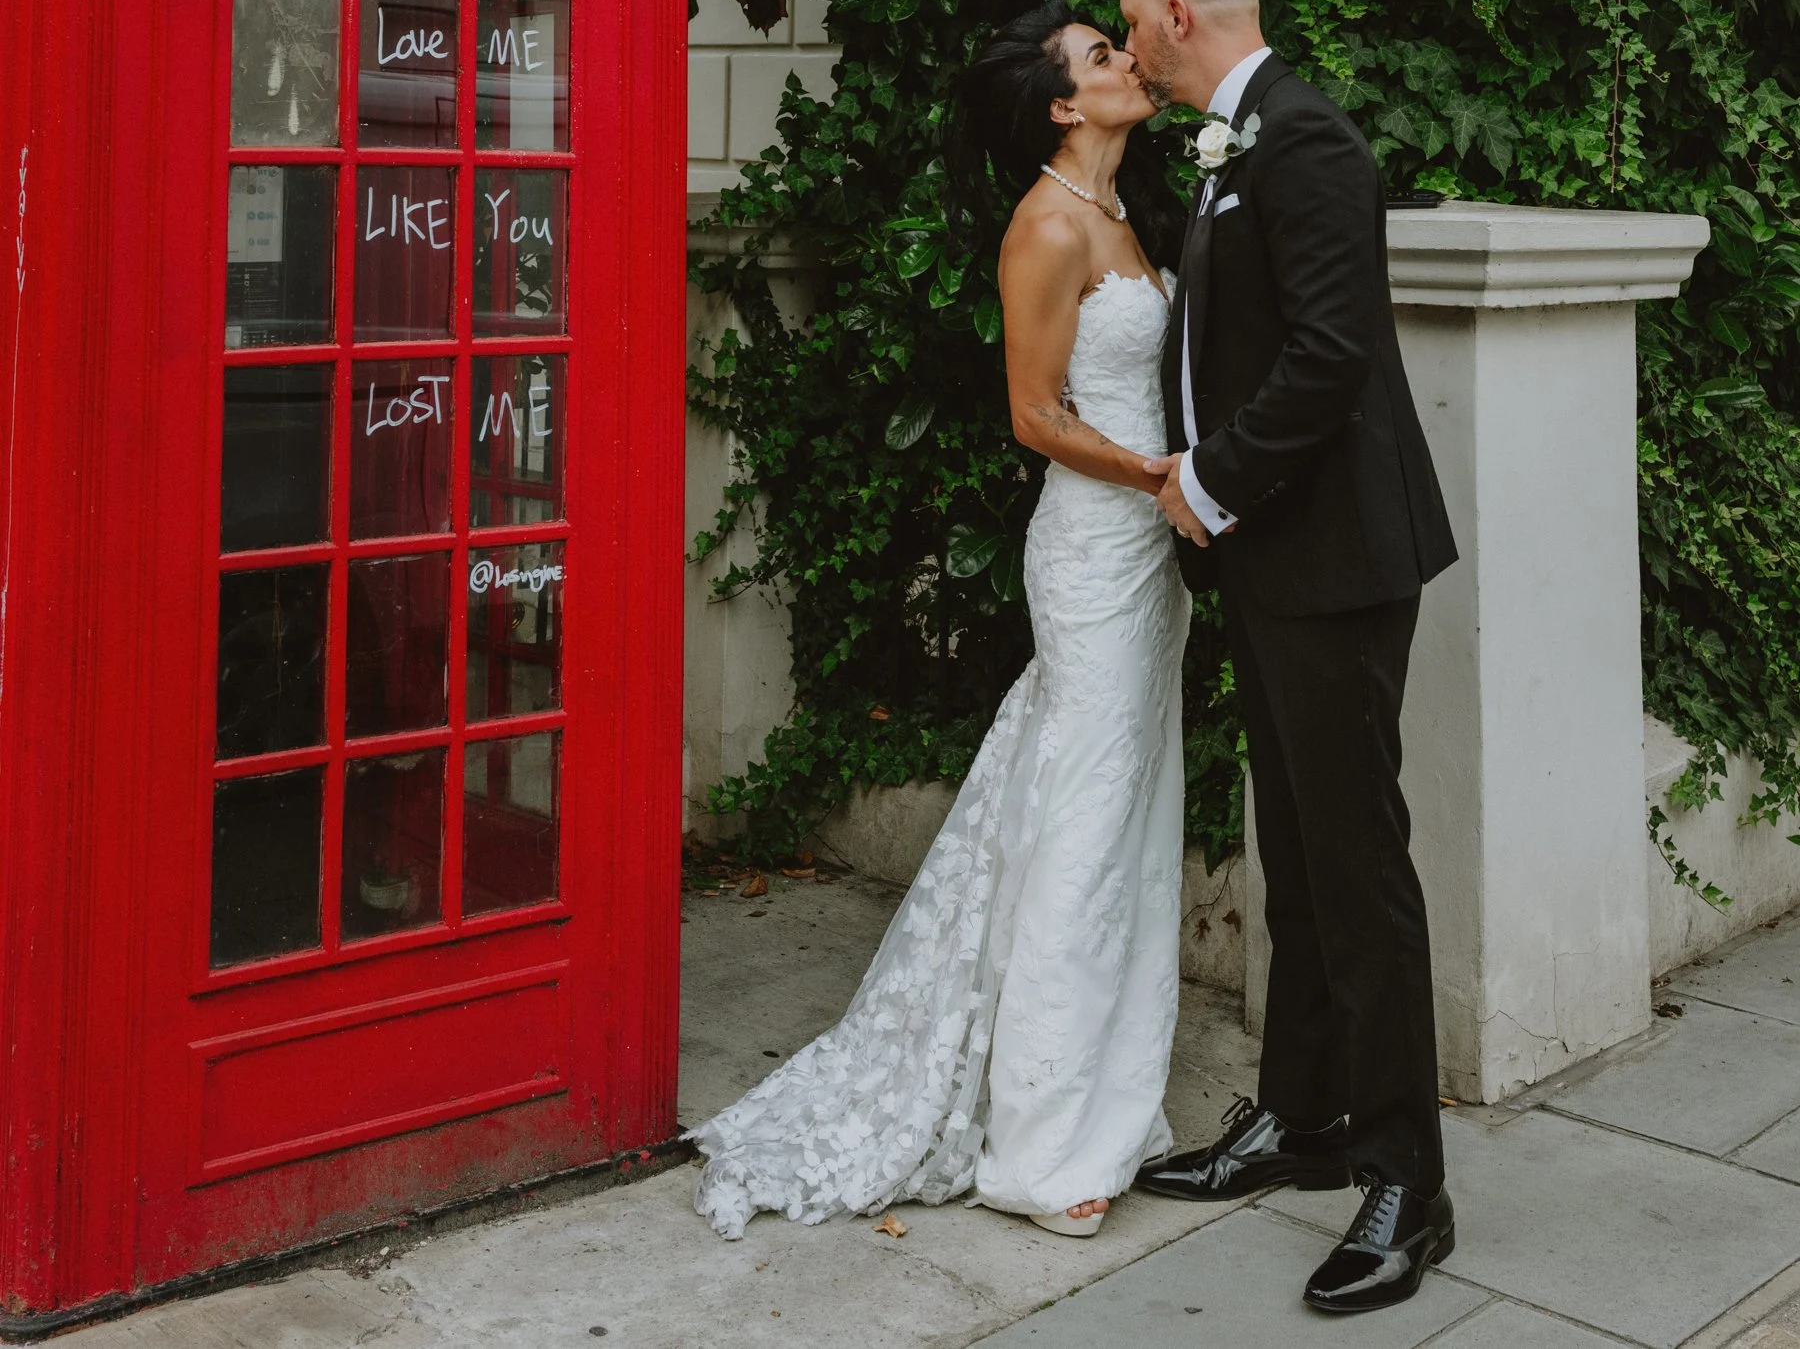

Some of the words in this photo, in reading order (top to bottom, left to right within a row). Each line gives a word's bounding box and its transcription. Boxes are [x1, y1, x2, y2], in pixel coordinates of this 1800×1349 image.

[488, 28, 544, 71] ME
[365, 186, 451, 249] LIKE
[478, 386, 553, 442] ME
